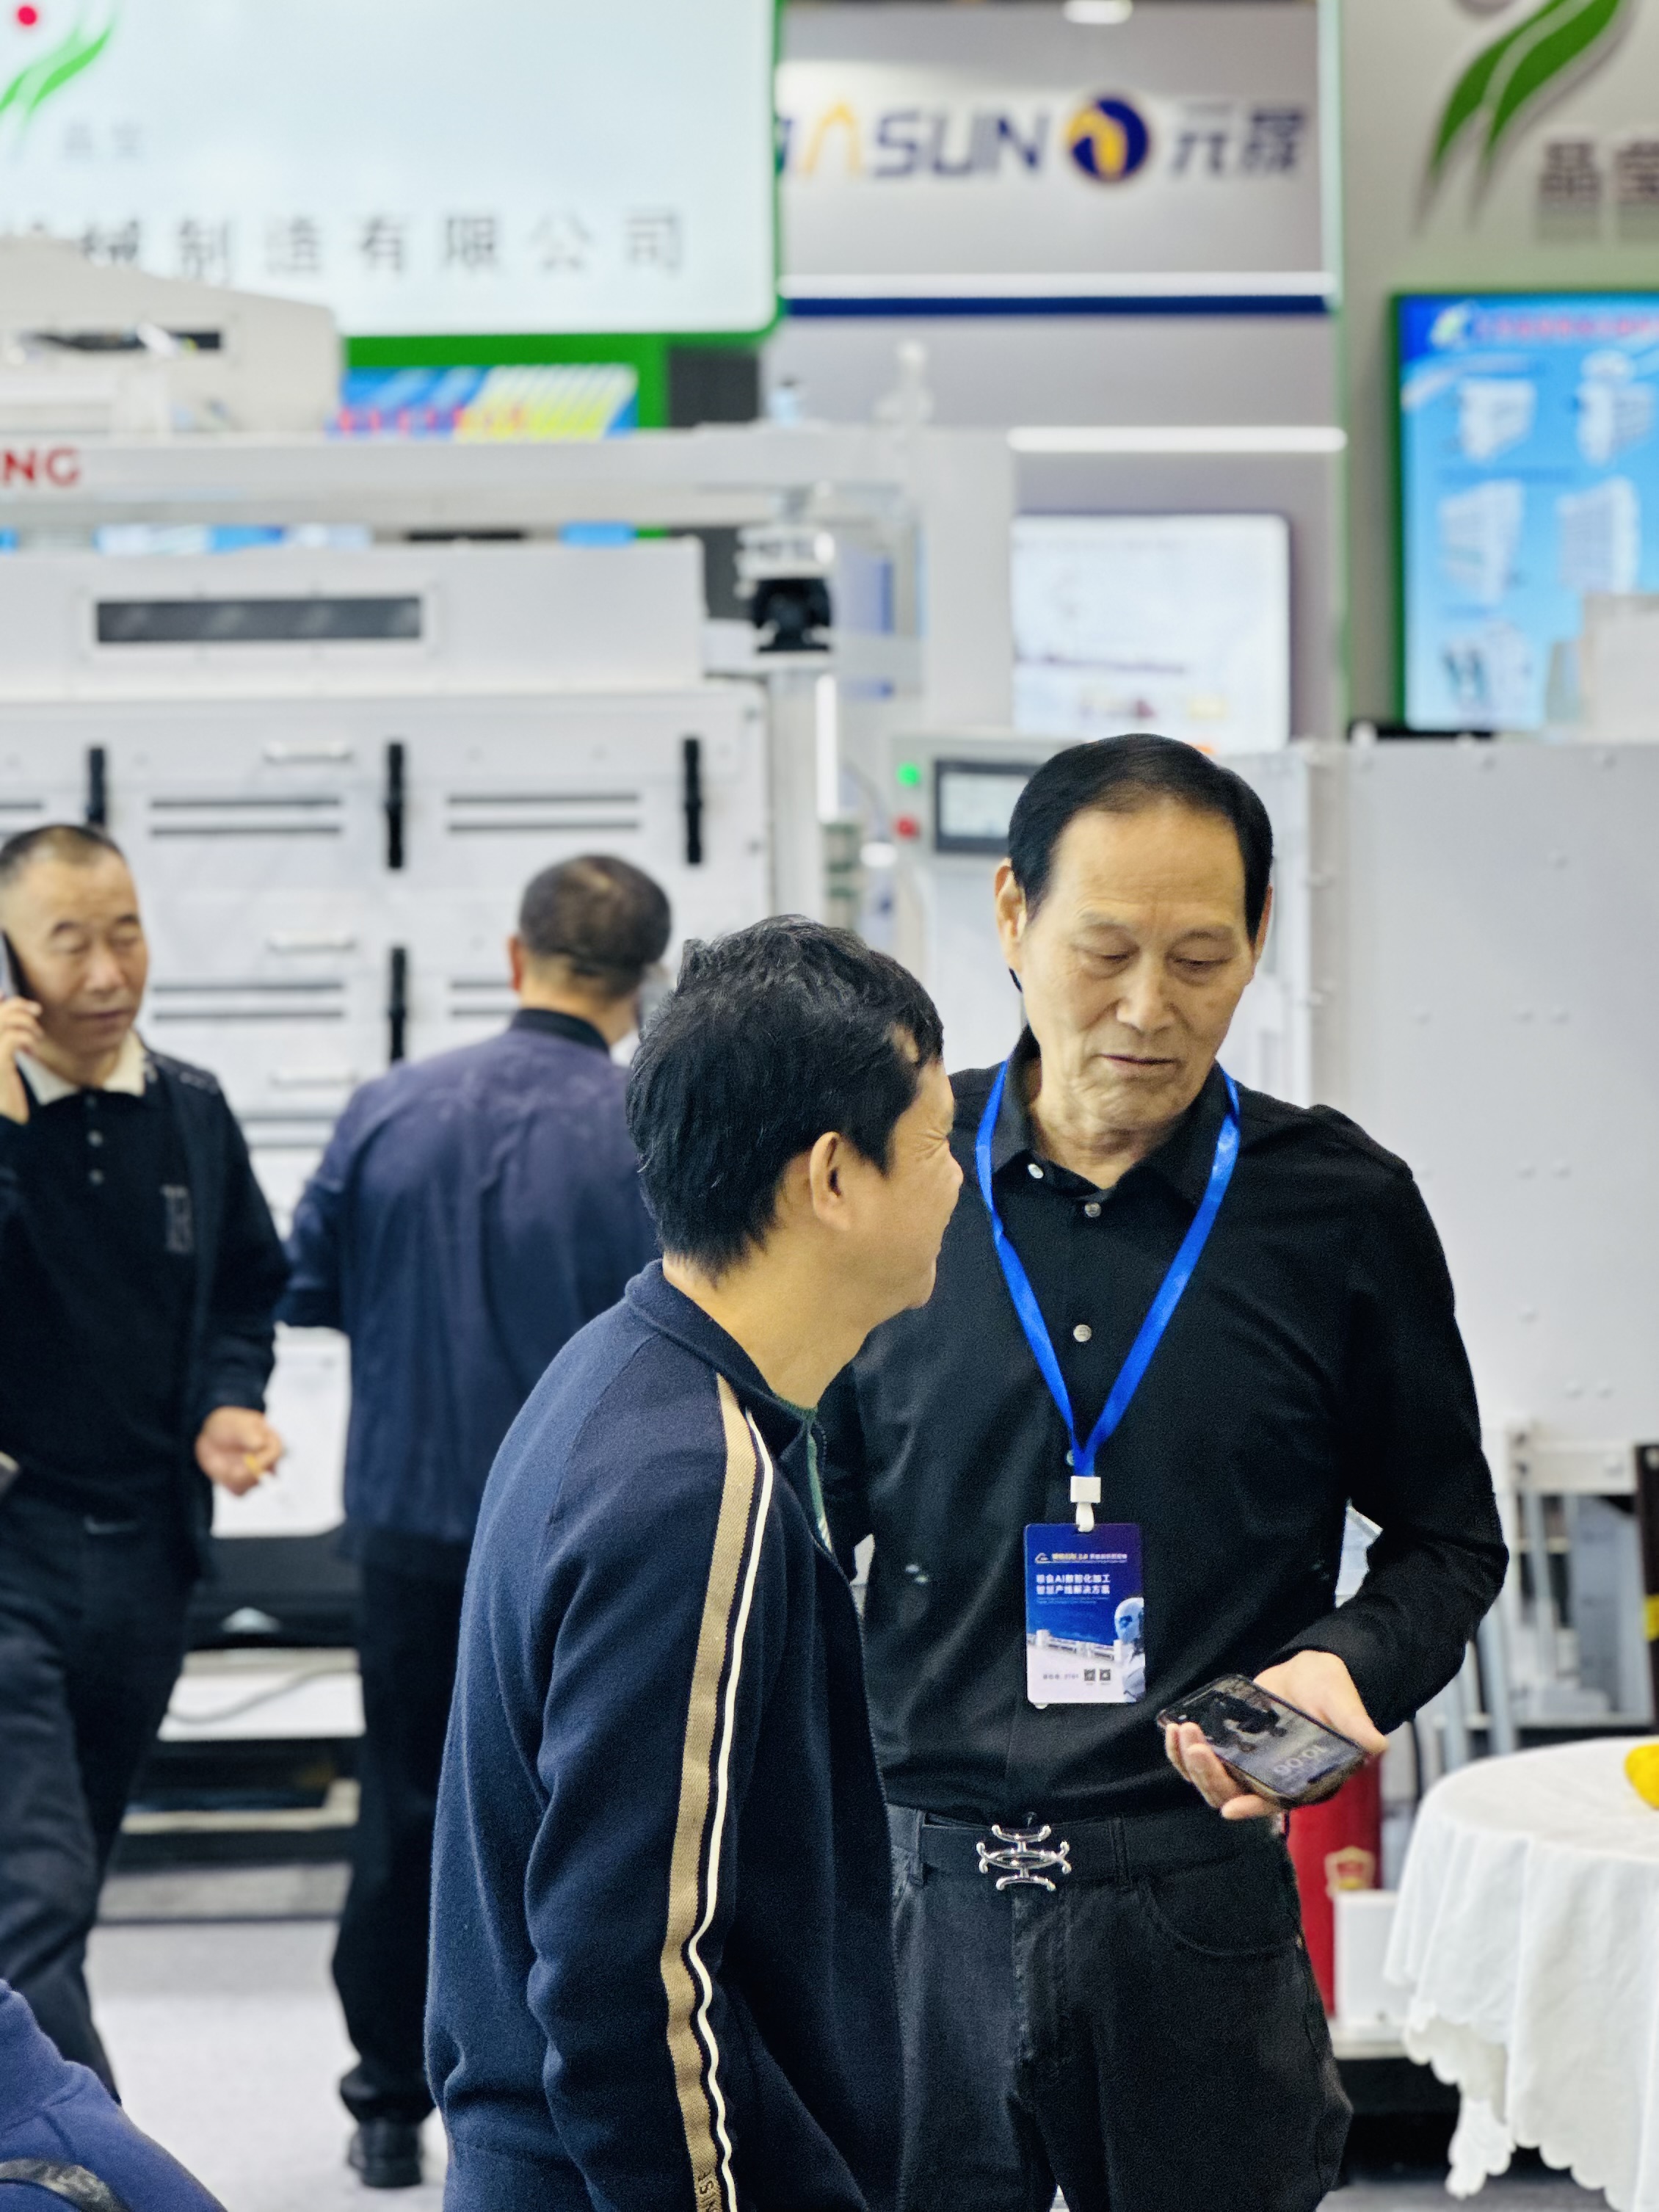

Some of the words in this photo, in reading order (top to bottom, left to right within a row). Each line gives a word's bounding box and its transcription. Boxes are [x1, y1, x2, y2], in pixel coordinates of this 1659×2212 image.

[0, 217, 681, 276] 械制造有限公司
